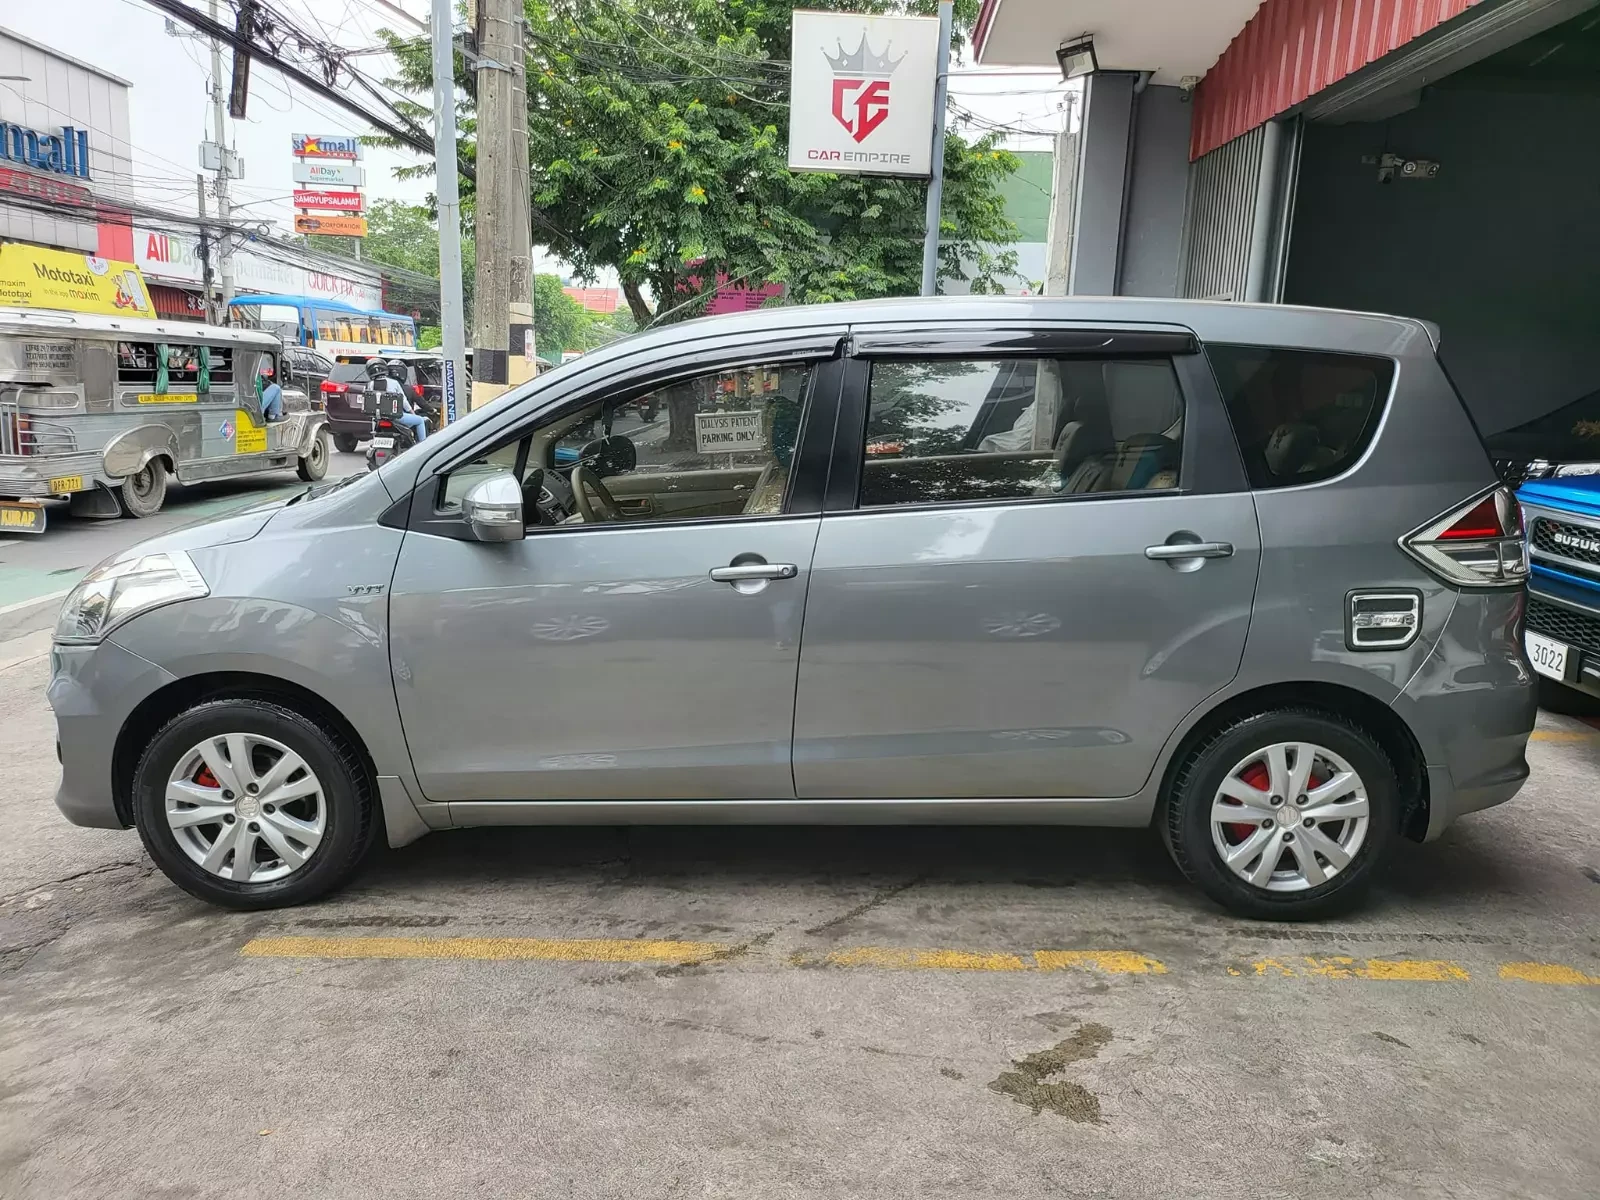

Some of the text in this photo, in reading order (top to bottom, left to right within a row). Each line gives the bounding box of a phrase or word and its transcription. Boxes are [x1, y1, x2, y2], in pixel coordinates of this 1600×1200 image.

[292, 137, 356, 153] strmall
[808, 150, 911, 164] CAR EMPIRE
[310, 166, 336, 177] AllDay
[309, 175, 344, 183] Supermarket
[294, 195, 360, 206] SAMGYUPSALAMAT
[33, 262, 95, 287] Mototaxi
[308, 270, 338, 294] QUICK
[0, 289, 32, 298] ototaxi
[68, 288, 101, 302] maxim
[446, 361, 455, 403] NAVARA
[700, 416, 729, 430] DIALYSIS
[701, 430, 756, 444] PARKING ONLY
[1533, 643, 1563, 673] 3022
